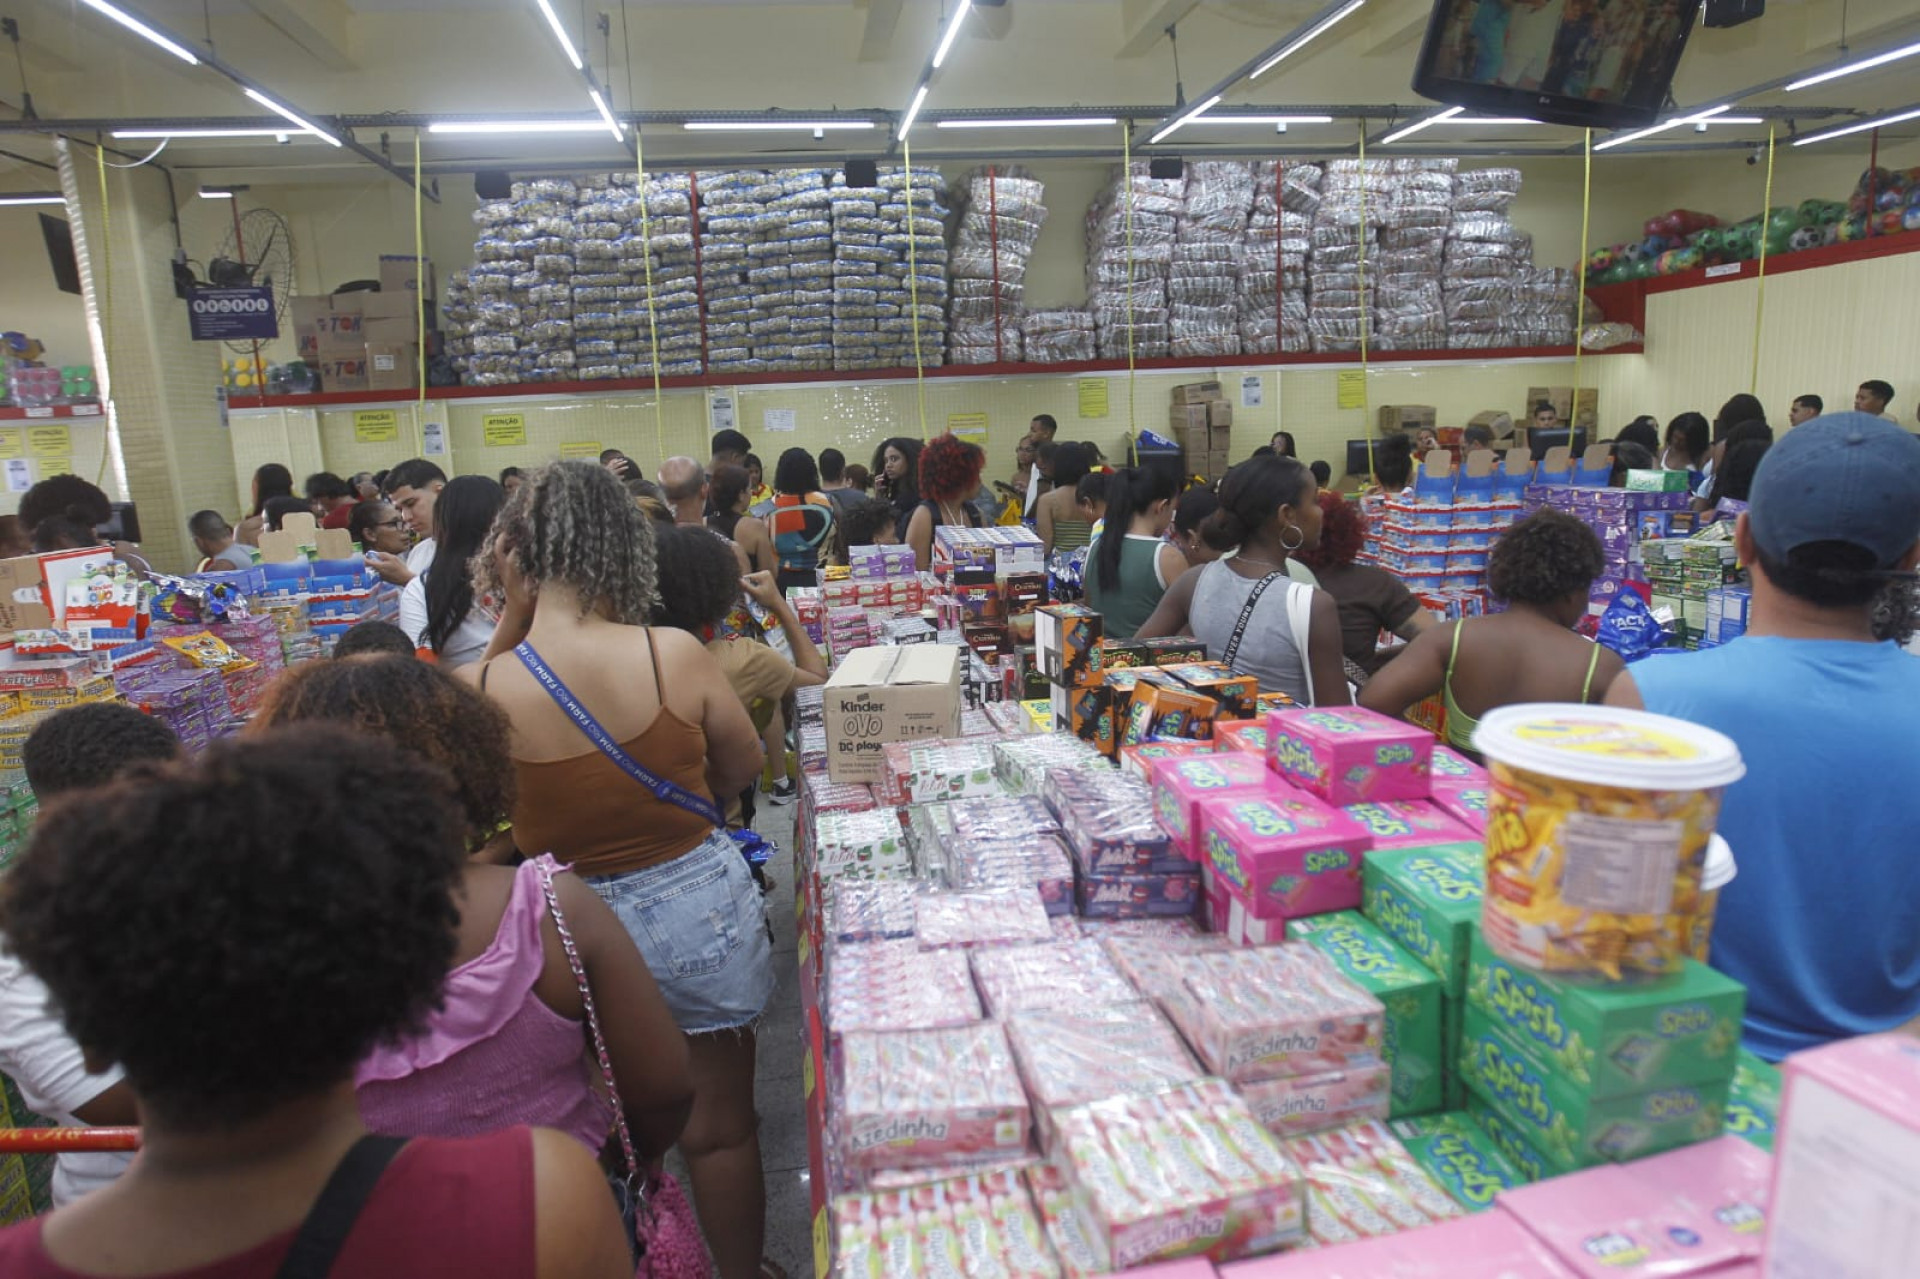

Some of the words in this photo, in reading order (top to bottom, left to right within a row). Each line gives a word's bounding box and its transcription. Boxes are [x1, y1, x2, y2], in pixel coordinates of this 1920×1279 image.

[535, 665, 558, 689] FARM
[567, 701, 591, 726] FARM
[840, 701, 885, 712] Kinder
[843, 713, 883, 738] OVO
[599, 737, 623, 760] FARM
[1277, 734, 1318, 779] Spish
[1377, 746, 1414, 765] Spish
[1305, 849, 1349, 874] Spish
[1408, 858, 1484, 900] Spish
[1326, 929, 1392, 972] Spish
[1494, 967, 1563, 1045] Spish
[1661, 1009, 1710, 1035] Spish
[1484, 1042, 1549, 1123] Spish
[1260, 1094, 1327, 1124] zedinha
[852, 1115, 947, 1150] Azedinha
[1432, 1138, 1503, 1203] Spish
